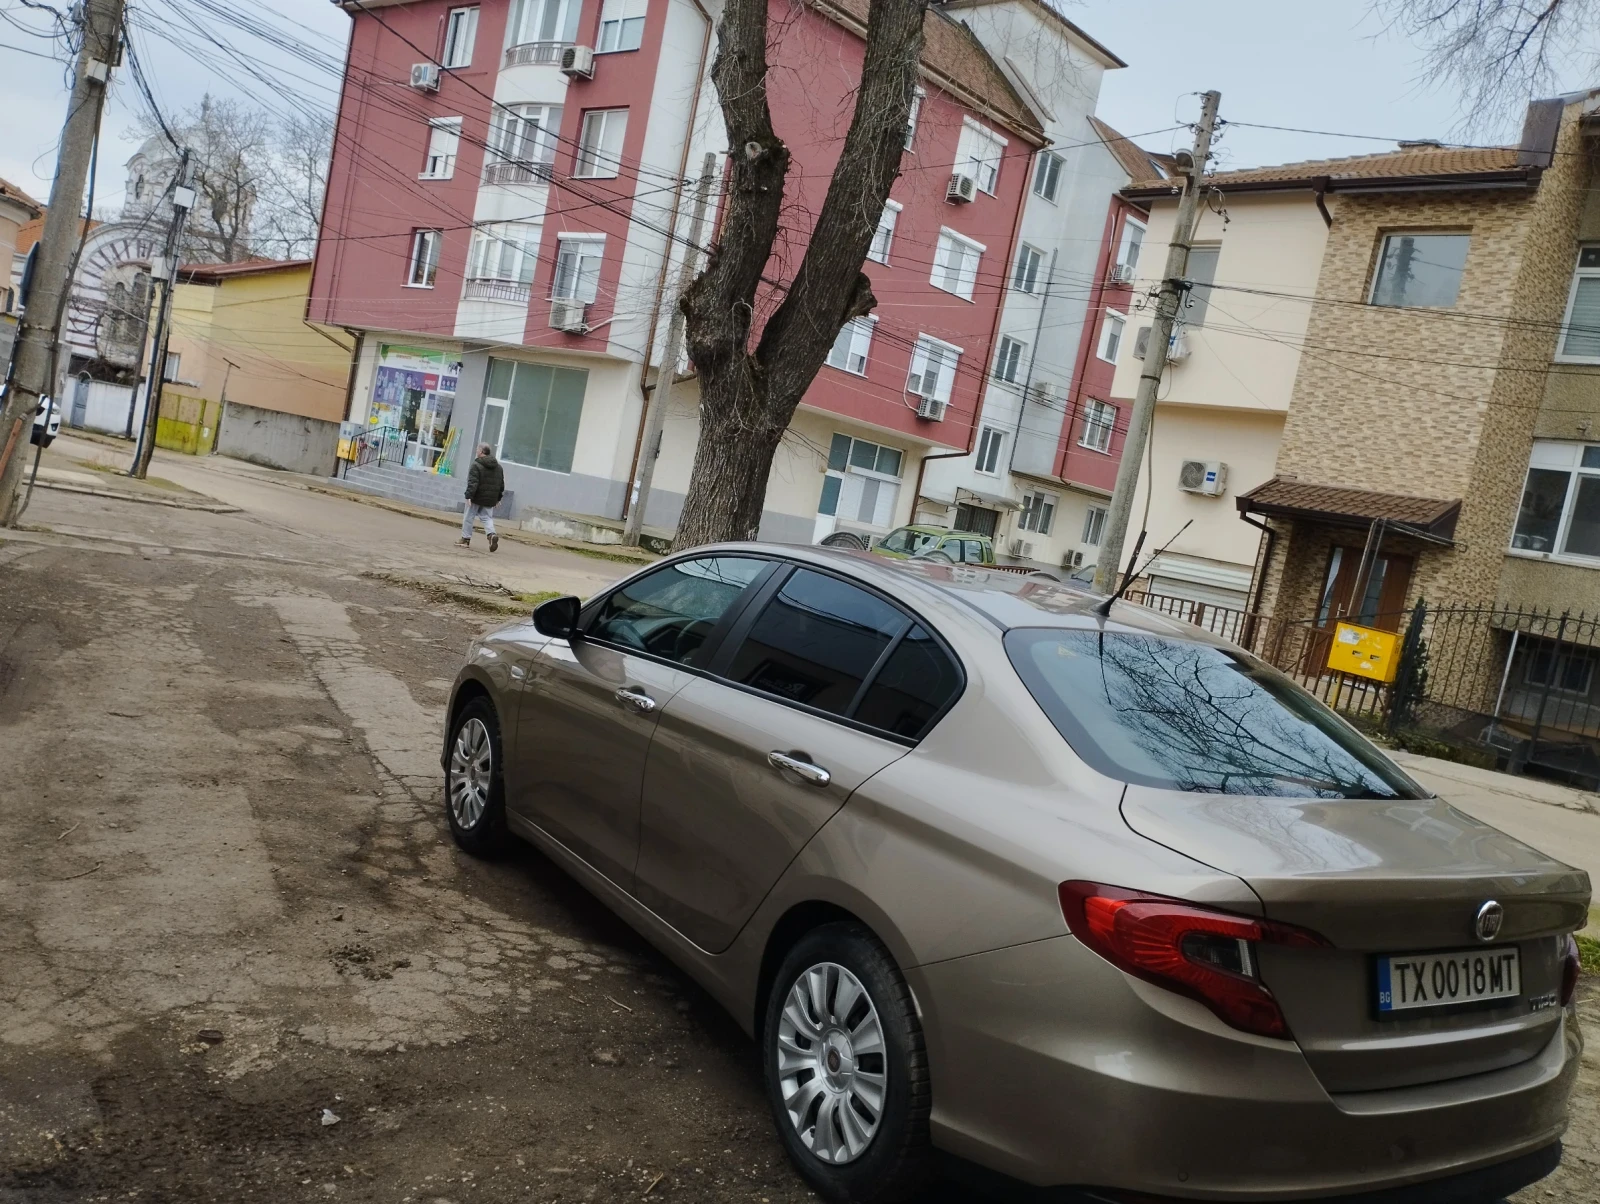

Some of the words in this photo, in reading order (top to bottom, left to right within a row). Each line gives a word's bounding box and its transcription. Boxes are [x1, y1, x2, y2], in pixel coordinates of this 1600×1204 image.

[1484, 914, 1500, 932] FIAT
[1380, 992, 1391, 1003] BG
[1528, 993, 1557, 1011] TIPO
